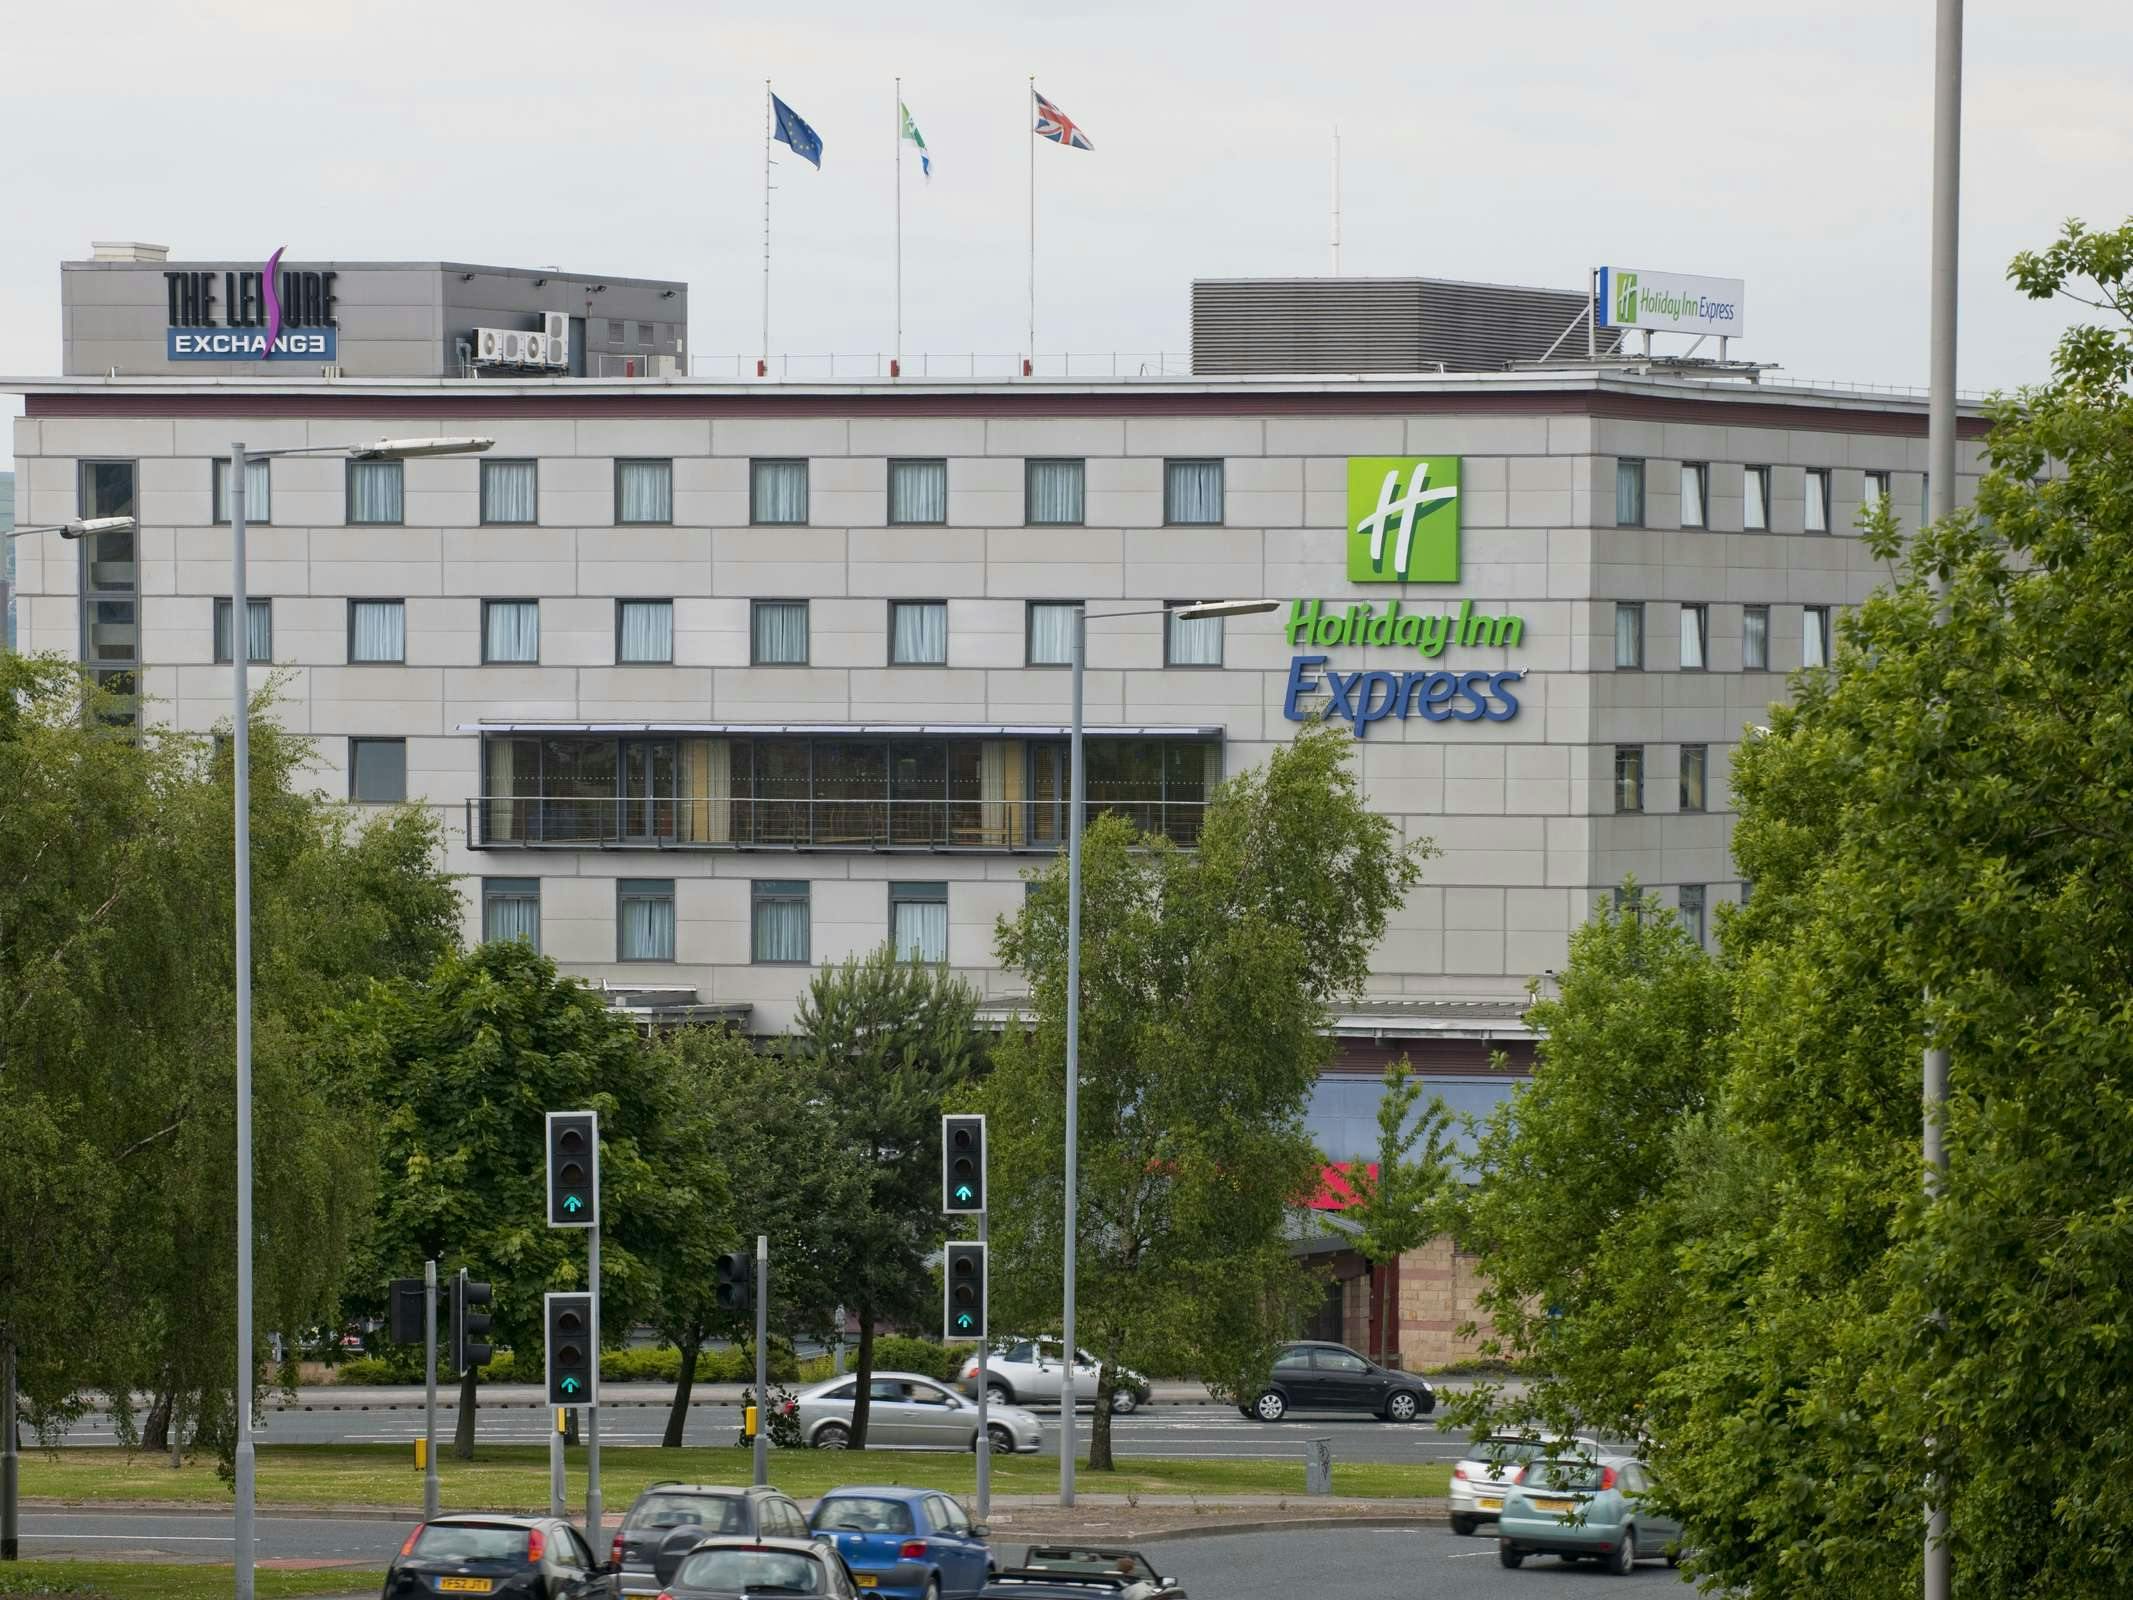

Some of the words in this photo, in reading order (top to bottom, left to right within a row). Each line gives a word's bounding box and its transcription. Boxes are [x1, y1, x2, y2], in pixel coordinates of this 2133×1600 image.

[163, 271, 217, 327] THE
[1640, 287, 1681, 321] Holiday
[1699, 296, 1735, 324] Express
[175, 335, 326, 353] EXCHANGE
[1284, 598, 1452, 658] Holiday
[1455, 599, 1525, 648] Inn
[1283, 655, 1522, 738] Express
